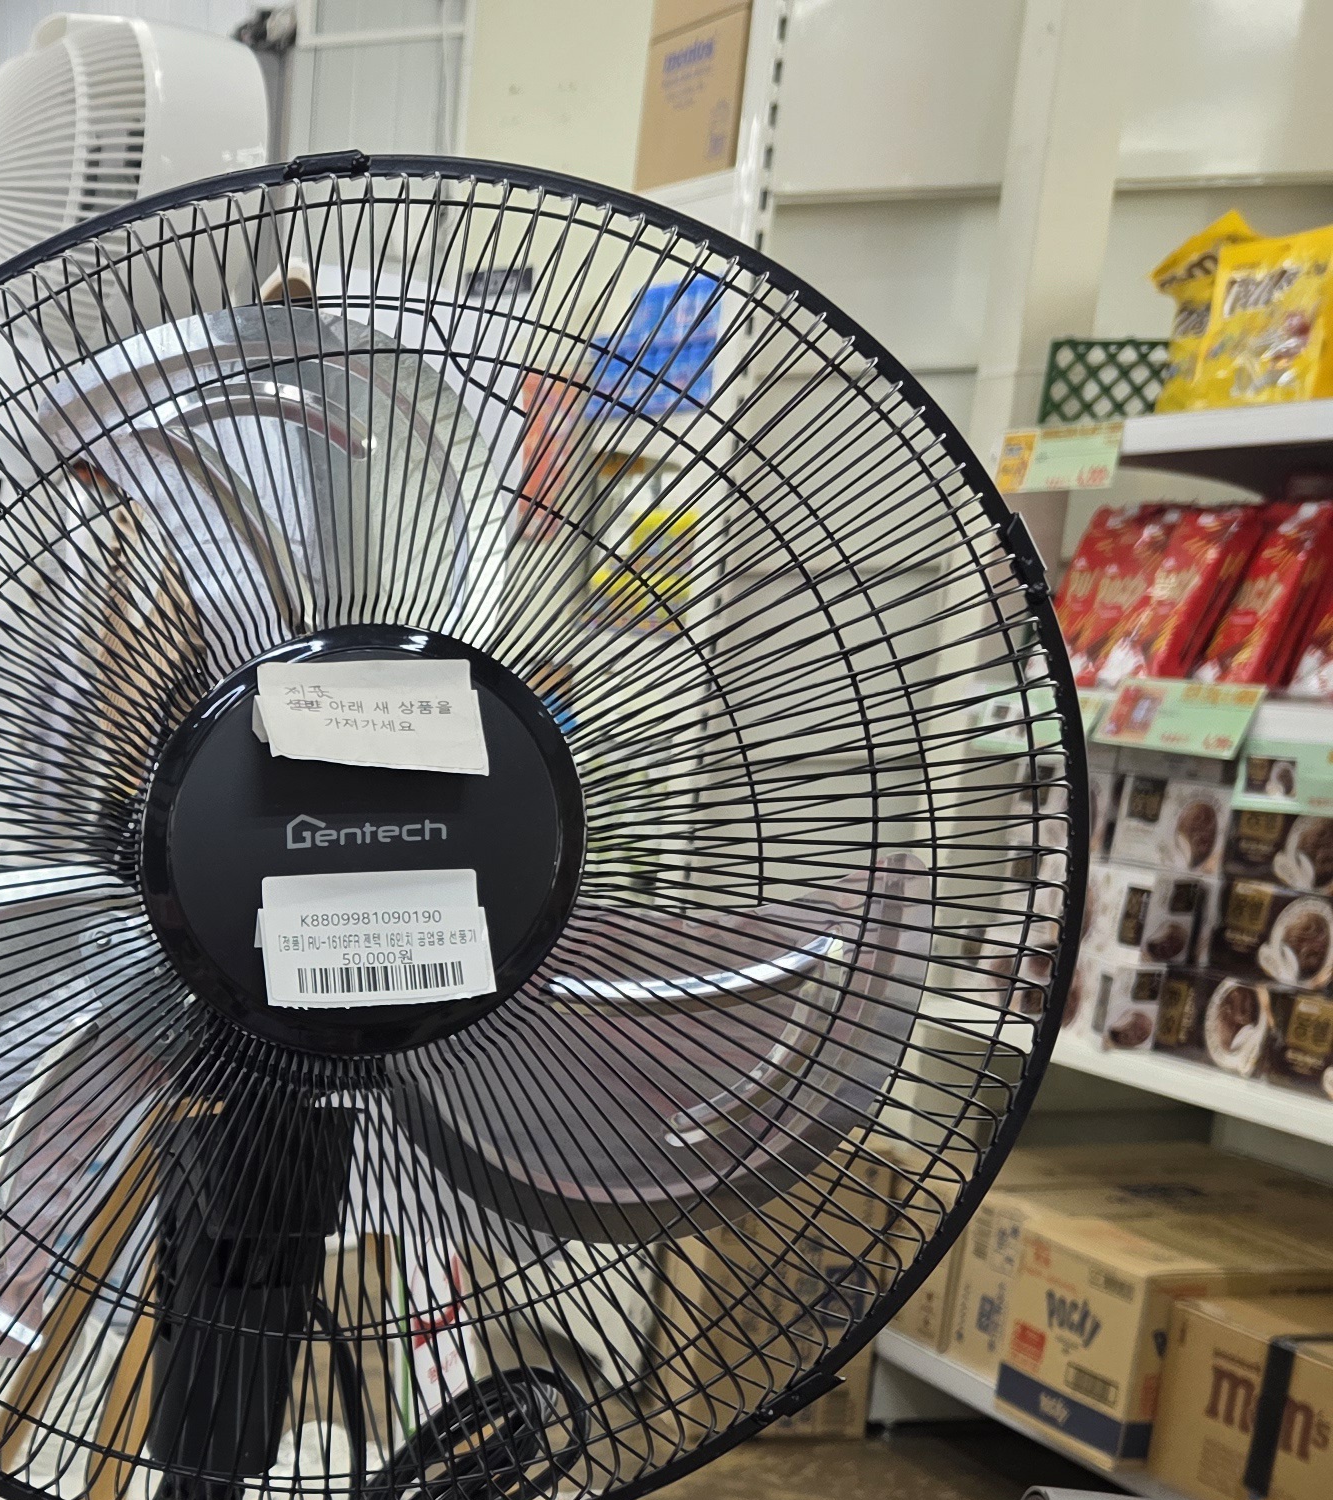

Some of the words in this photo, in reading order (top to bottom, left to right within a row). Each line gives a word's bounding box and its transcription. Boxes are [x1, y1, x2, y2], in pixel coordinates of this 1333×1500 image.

[329, 700, 364, 714] 아래
[373, 700, 389, 714] 새
[398, 700, 453, 715] 상품을
[286, 814, 447, 850] Gentech
[300, 909, 442, 928] K8809981090190
[278, 934, 305, 952] [정품]
[385, 931, 413, 949] 16인치
[417, 930, 445, 947] 공업용
[449, 929, 477, 945] 선풍기
[342, 948, 413, 966] 50,000원
